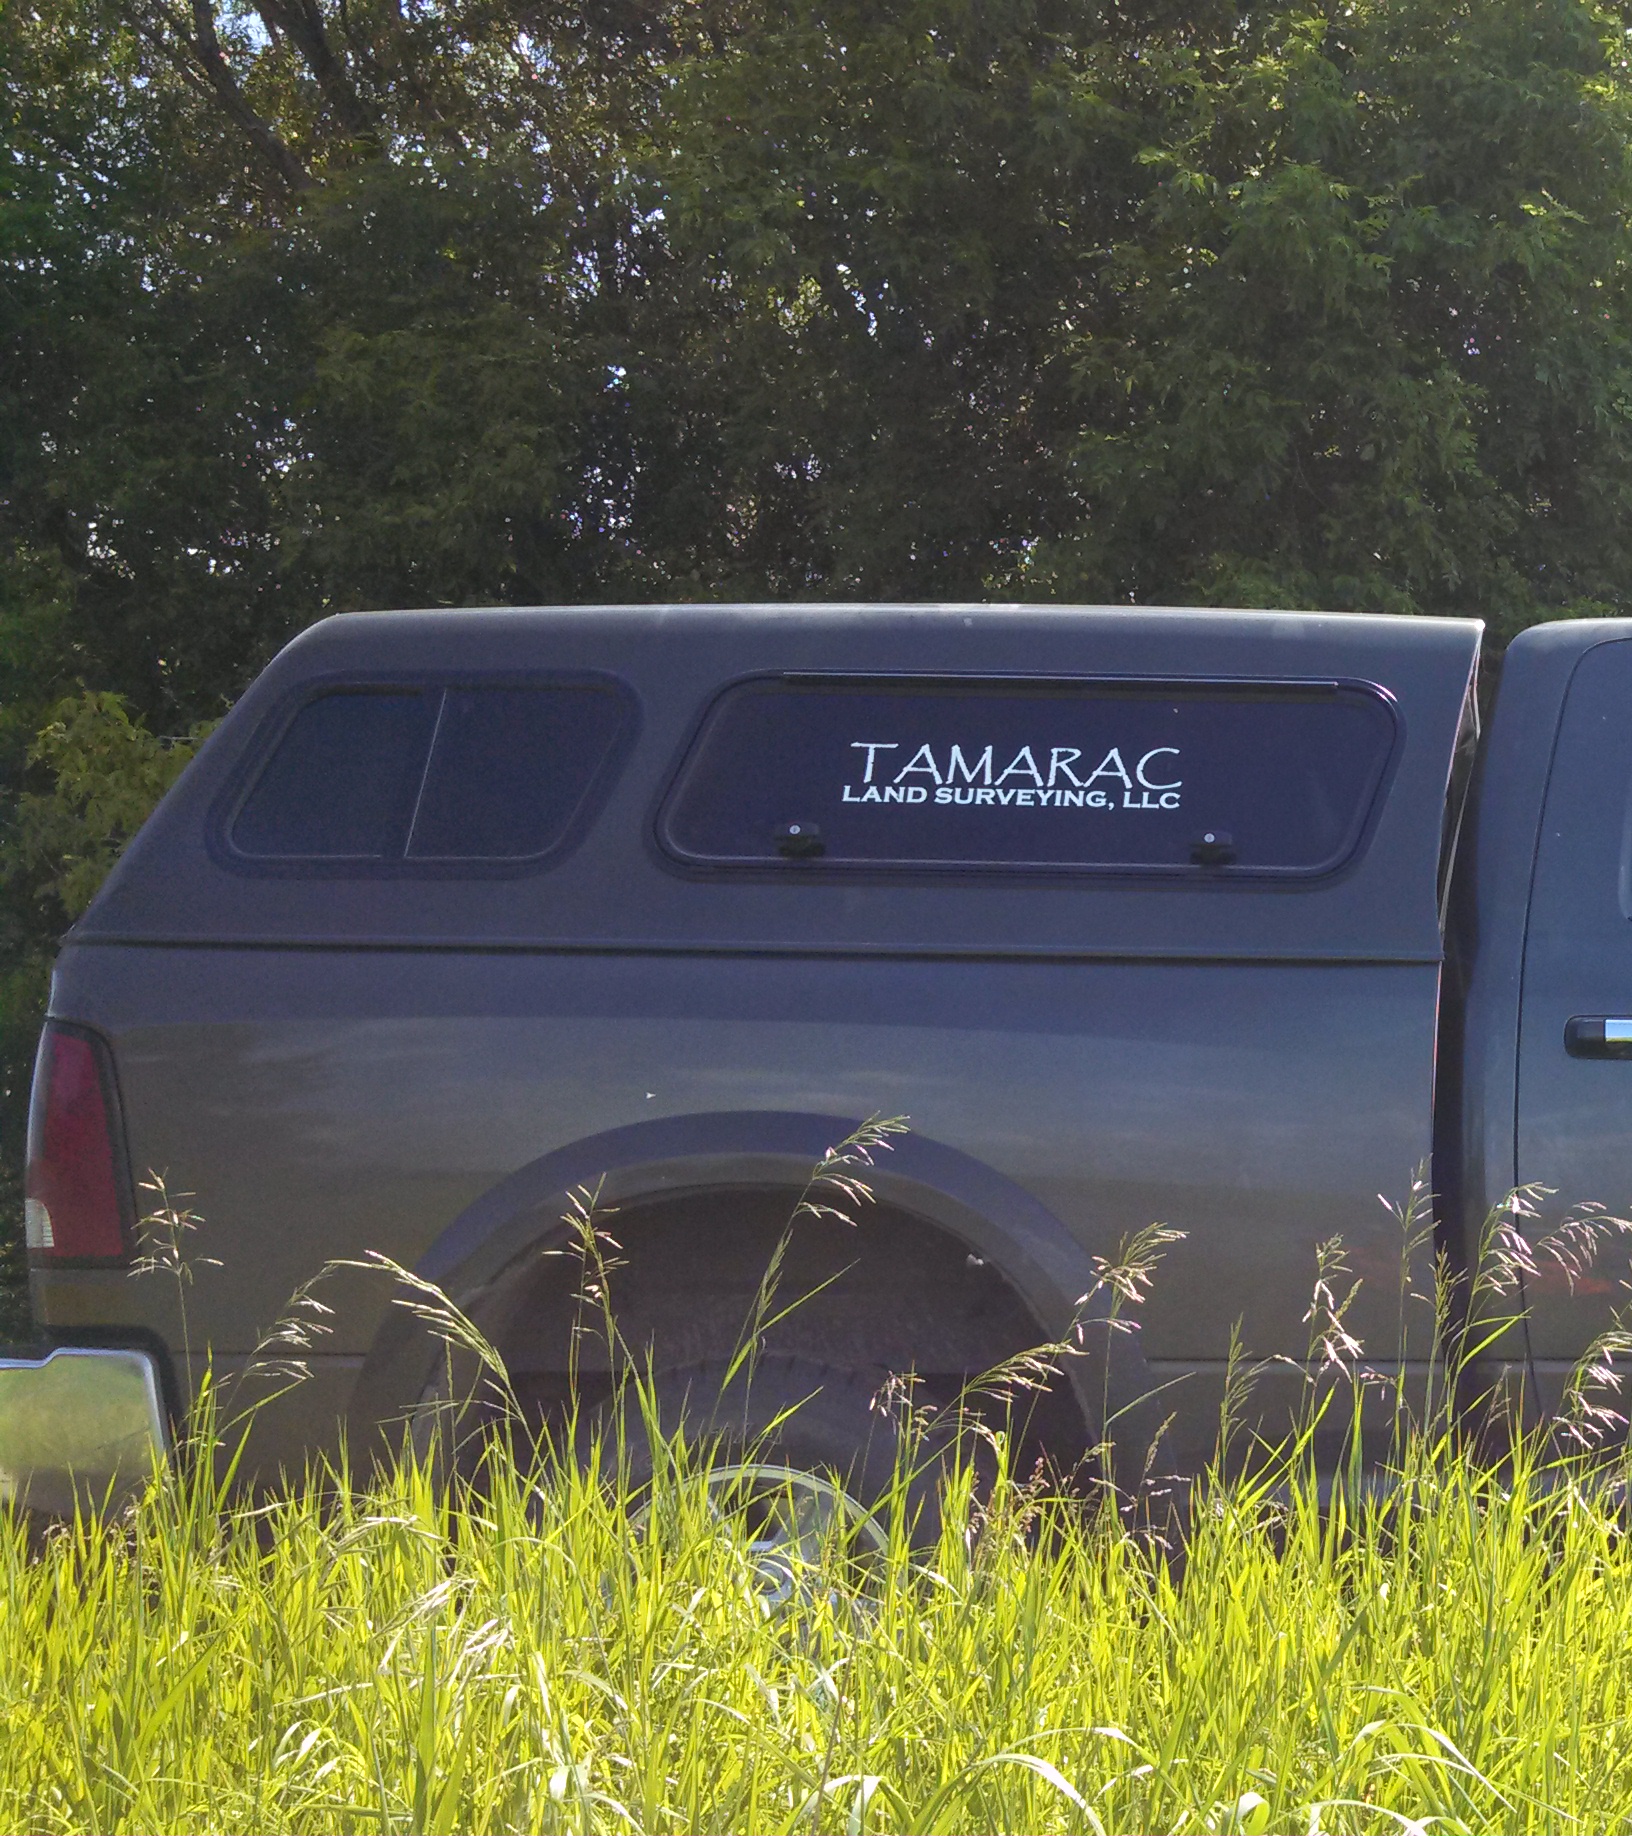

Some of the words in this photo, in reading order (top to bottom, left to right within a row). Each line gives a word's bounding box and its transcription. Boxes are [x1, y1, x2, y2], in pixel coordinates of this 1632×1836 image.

[850, 741, 1183, 790] TAMARAC
[841, 785, 928, 804] LAND
[933, 787, 1115, 811] SURVEYING,
[1122, 791, 1181, 809] LLC
